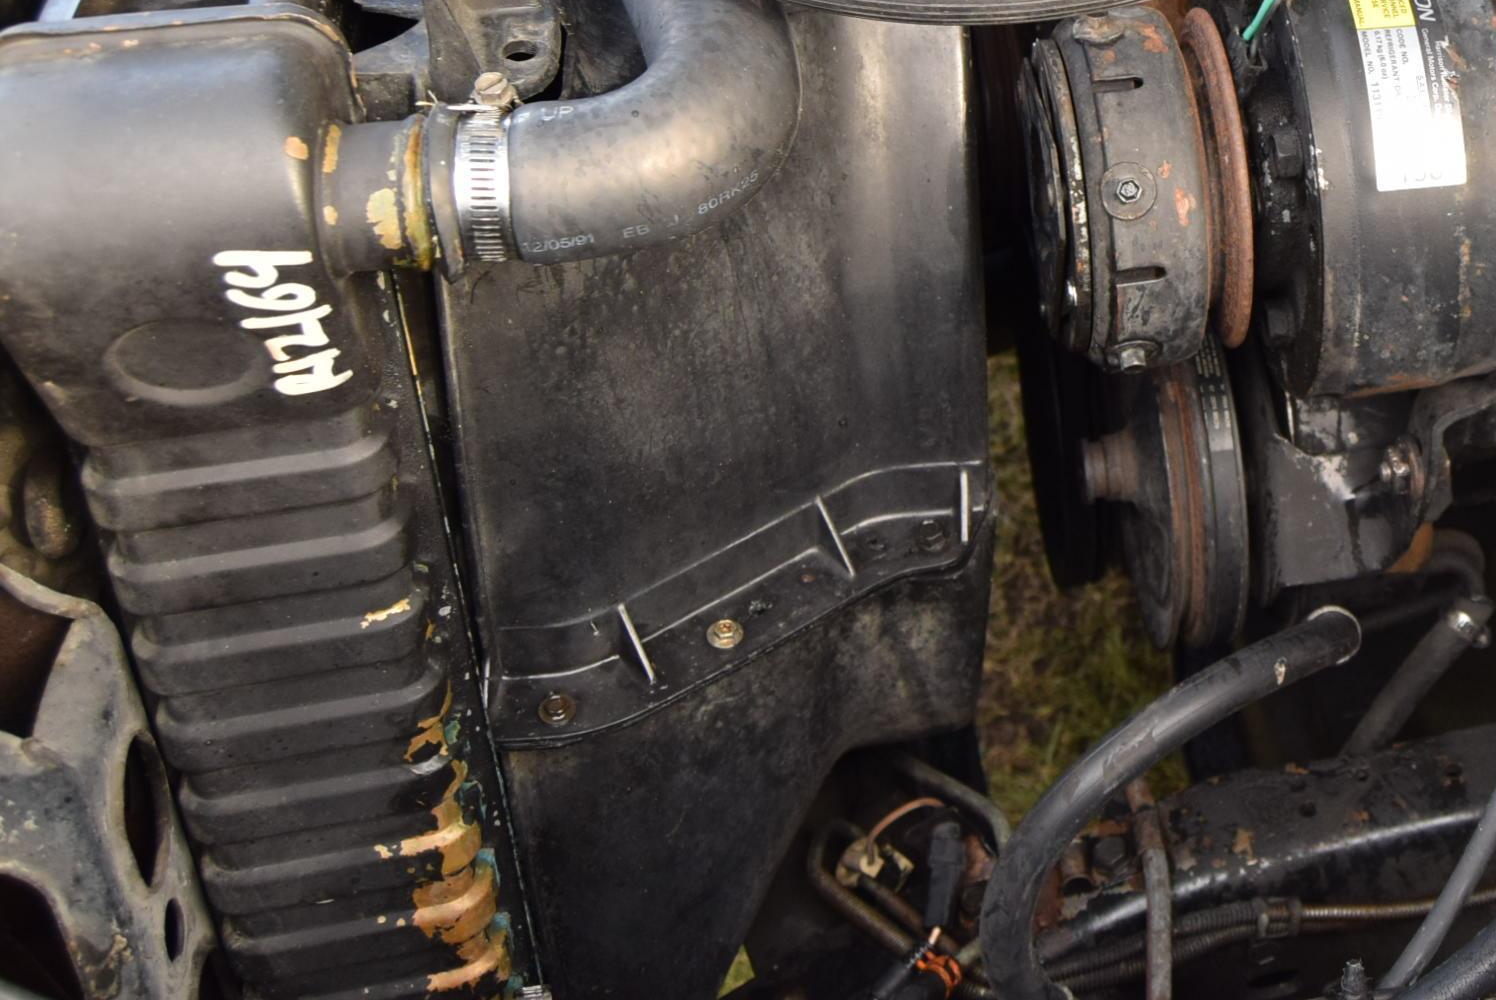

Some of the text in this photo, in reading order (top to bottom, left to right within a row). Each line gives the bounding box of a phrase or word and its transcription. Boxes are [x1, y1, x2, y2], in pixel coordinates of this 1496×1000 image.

[1361, 31, 1371, 57] MODEL
[1367, 61, 1375, 74] NO.
[1384, 29, 1400, 81] REFRIGERANT
[1396, 29, 1409, 64] CODE NO.
[1421, 28, 1433, 55] General
[1434, 40, 1445, 73] Harrison
[1427, 55, 1436, 81] Motors
[1431, 82, 1440, 104] Corp.
[540, 105, 574, 121] UP
[697, 169, 759, 215] 80RK25
[622, 224, 650, 240] EB
